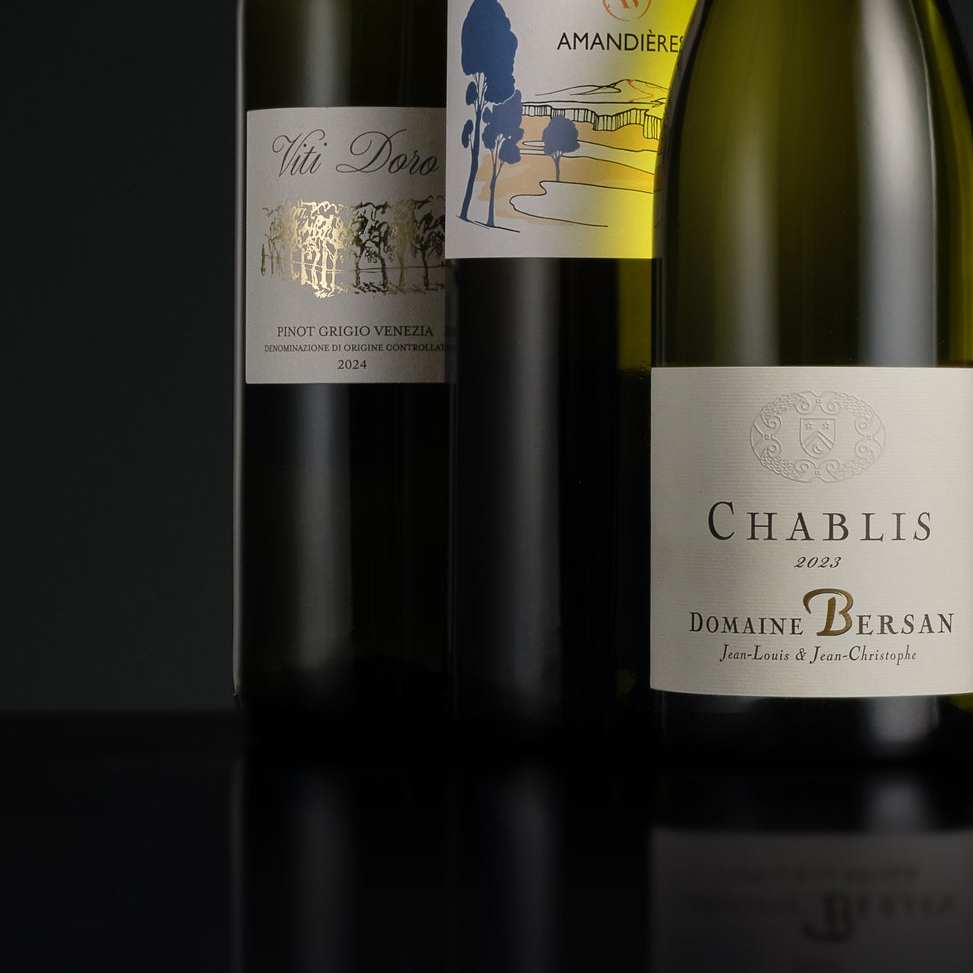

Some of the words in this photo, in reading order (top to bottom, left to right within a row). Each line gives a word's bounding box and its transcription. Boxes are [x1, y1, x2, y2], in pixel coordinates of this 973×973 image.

[272, 129, 327, 177] Viti
[335, 128, 439, 176] Doro
[277, 326, 316, 337] PINOT
[318, 326, 370, 337] GRIGIO
[373, 325, 434, 337] VENEZIA
[264, 343, 329, 352] DENOMINAZIONE
[331, 343, 341, 352] DI
[343, 343, 384, 352] ORIGINE
[386, 344, 446, 352] CONTROLLAT
[337, 359, 367, 370] 2024
[794, 556, 841, 569] 2023
[719, 642, 789, 662] Jean-Louis
[795, 644, 808, 661] &
[809, 643, 916, 665] Jean-Christophe
